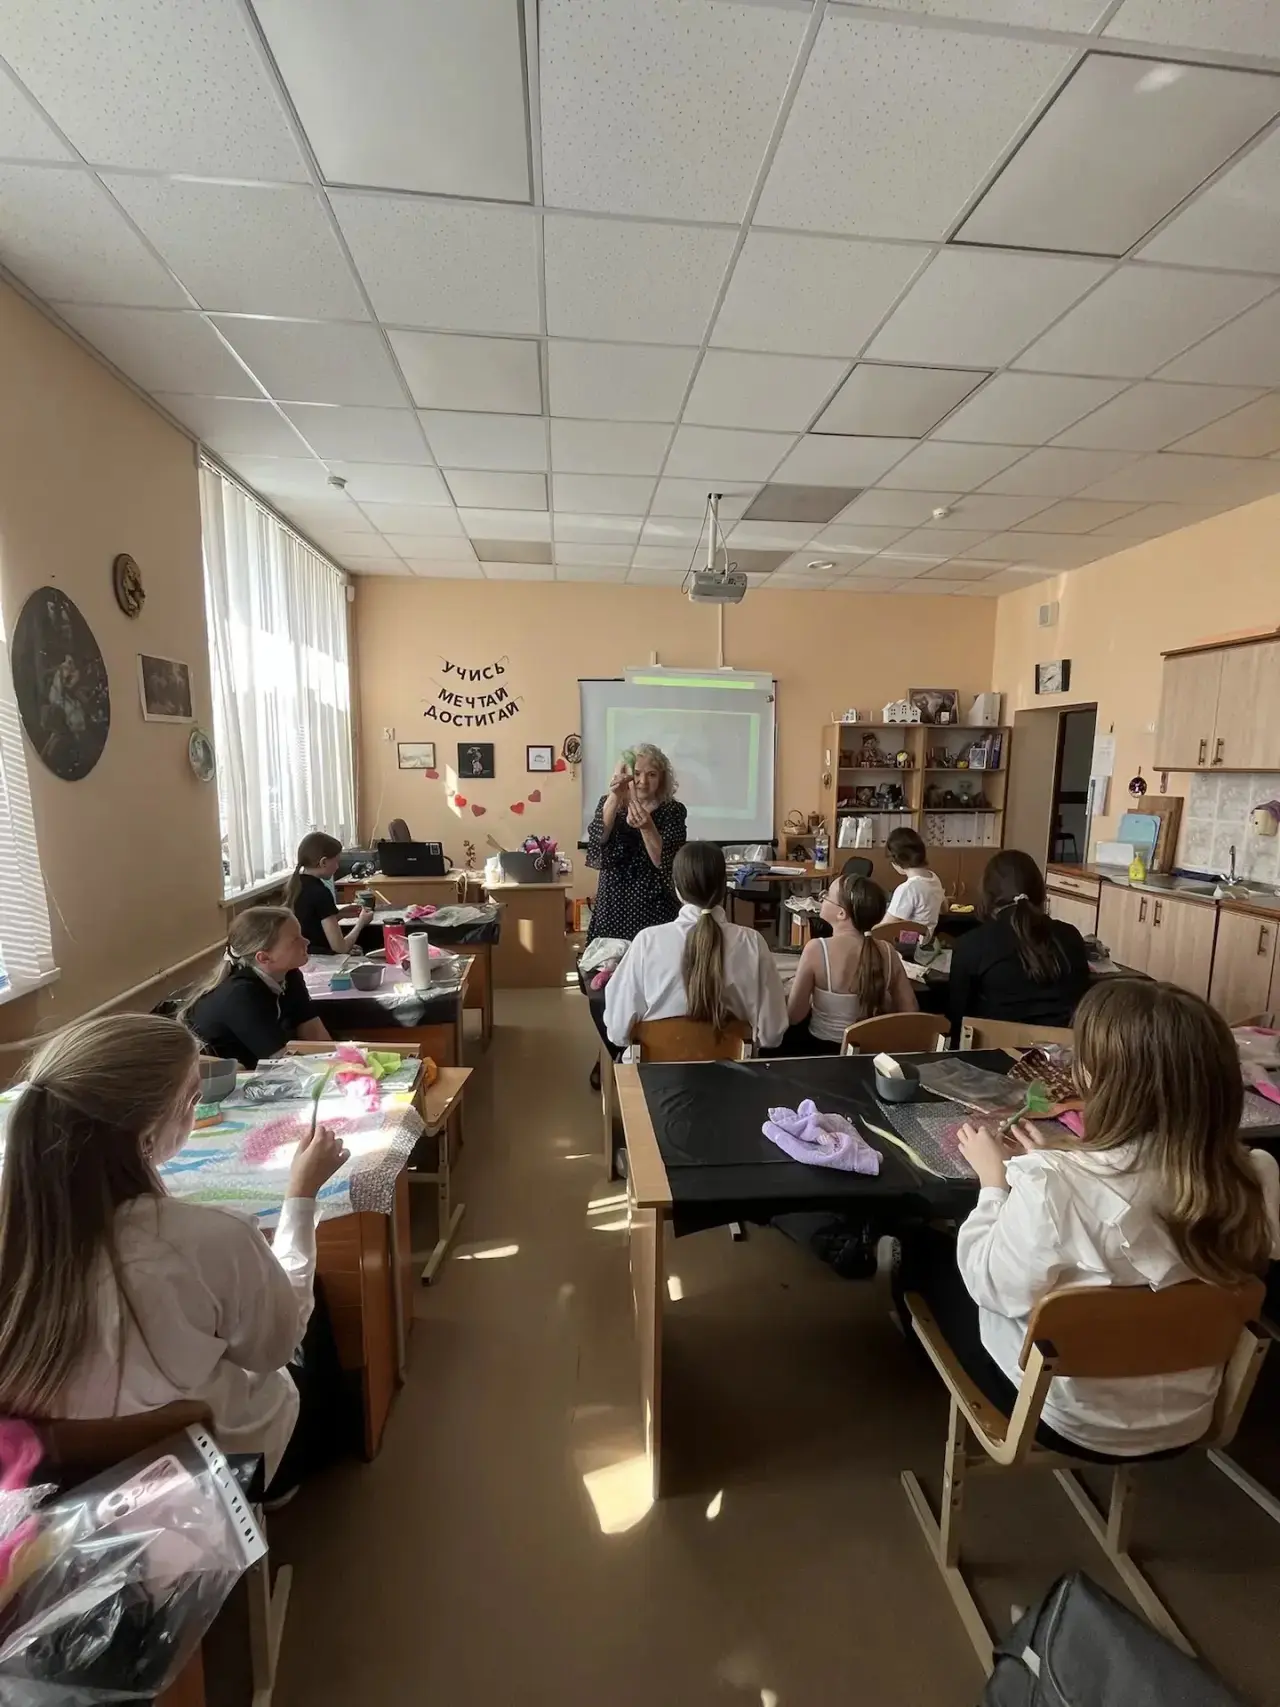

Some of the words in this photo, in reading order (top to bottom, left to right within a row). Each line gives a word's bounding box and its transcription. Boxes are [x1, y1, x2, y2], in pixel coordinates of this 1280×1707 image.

[442, 661, 505, 681] УЧИСЬ
[438, 687, 508, 709] МЕЧТАЙ
[423, 701, 520, 727] ДОСТИГАЙ
